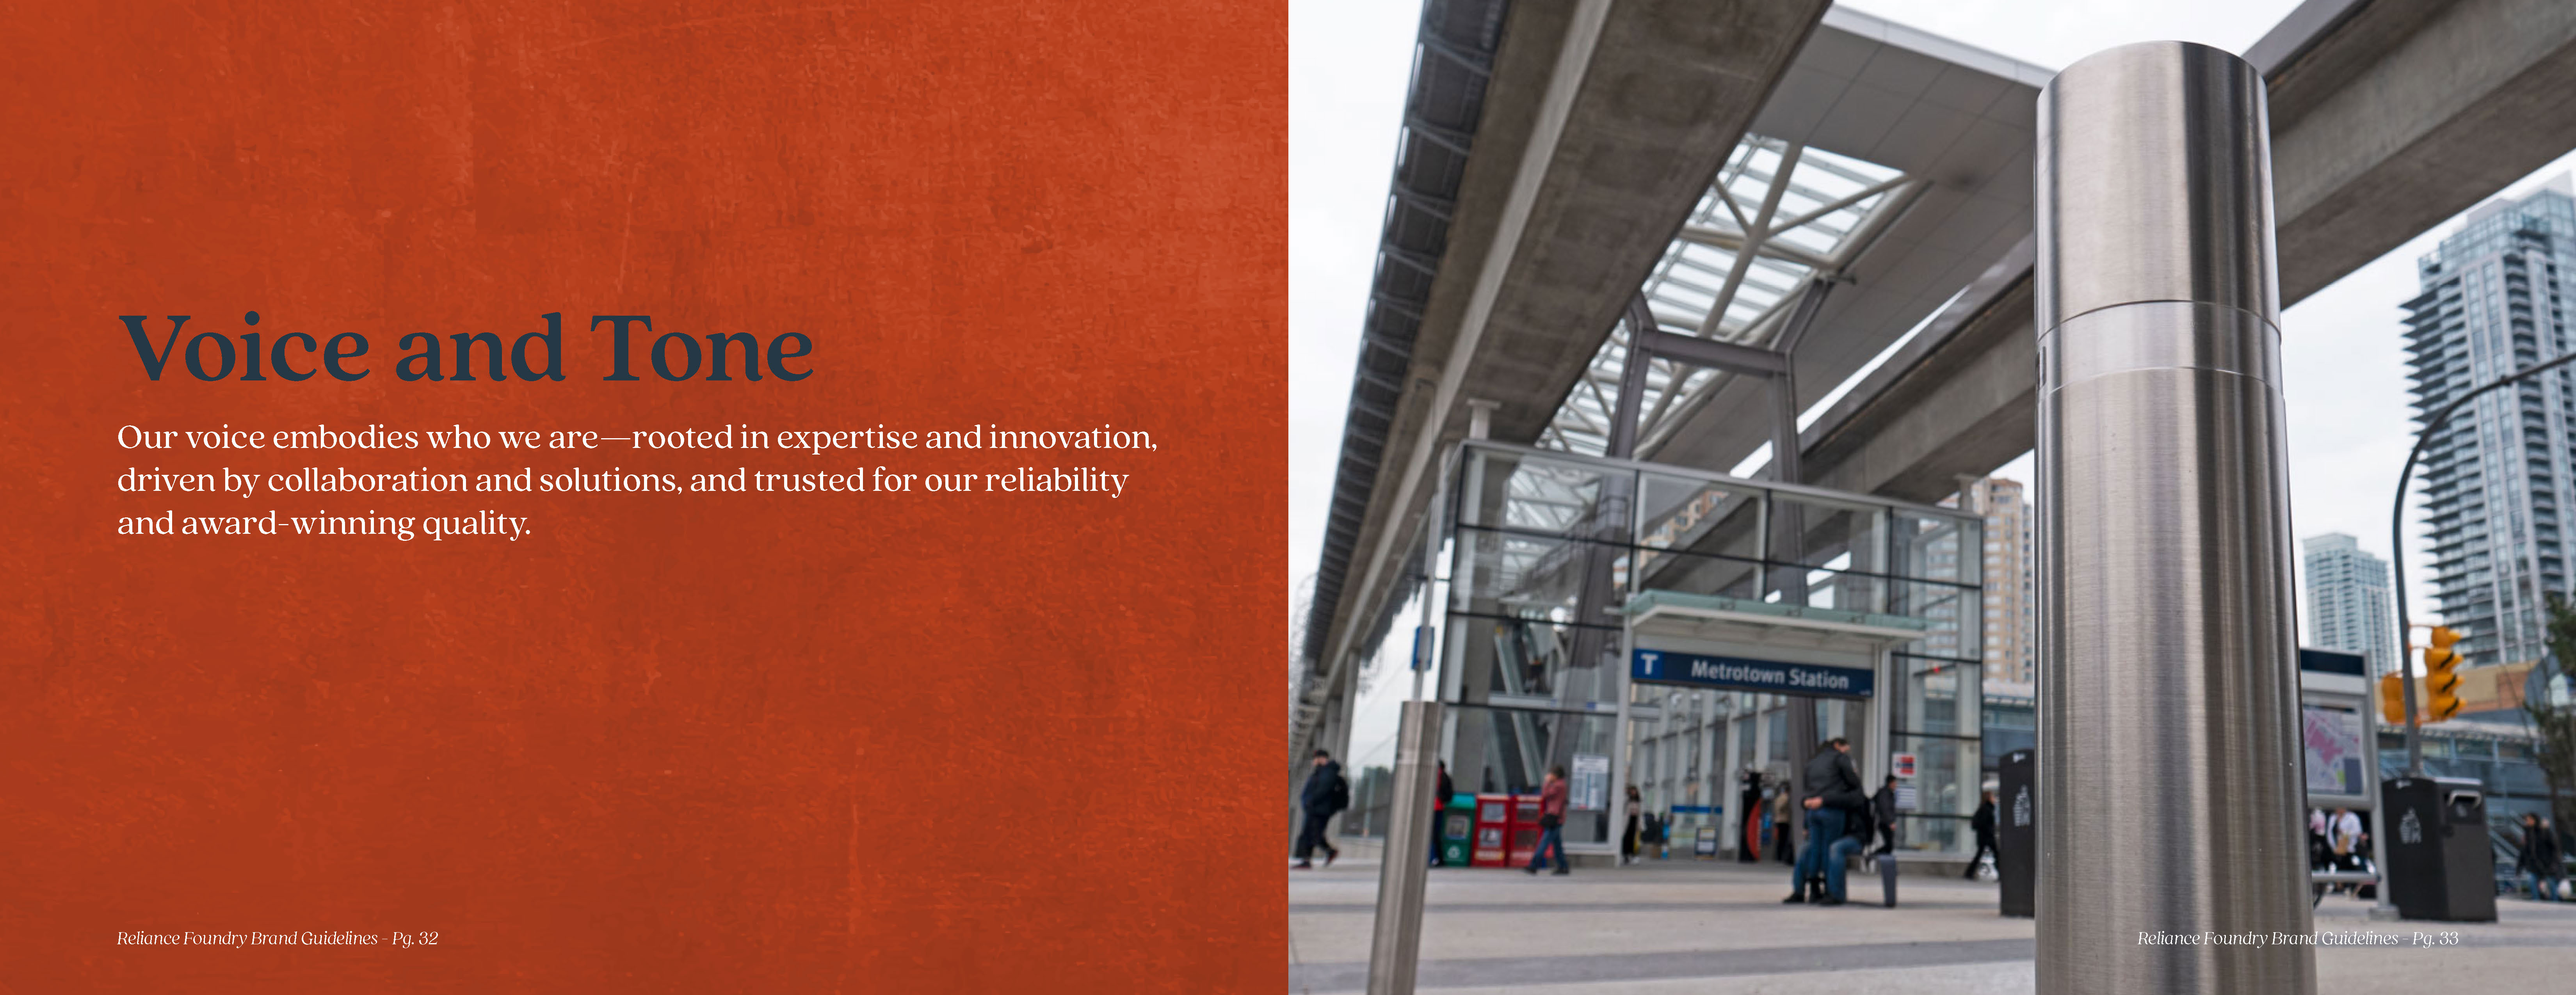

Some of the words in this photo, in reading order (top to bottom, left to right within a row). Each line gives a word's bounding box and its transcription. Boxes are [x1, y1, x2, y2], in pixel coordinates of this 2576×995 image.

[1641, 654, 1658, 674] T
[1691, 659, 1785, 684] Metrotown
[1789, 668, 1849, 689] Station
